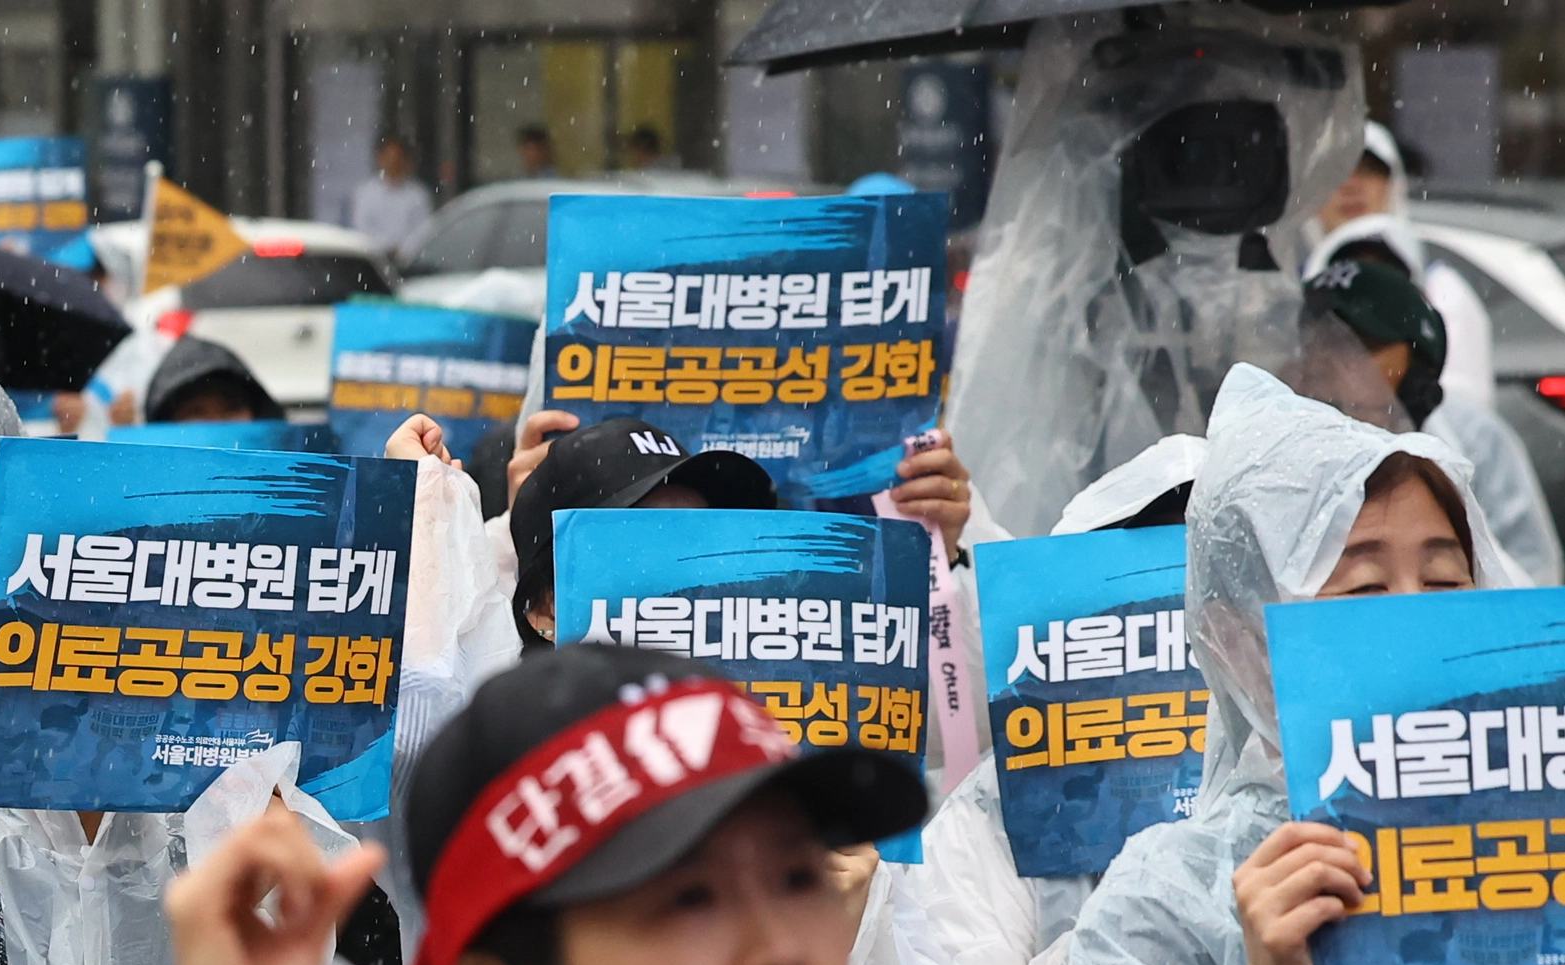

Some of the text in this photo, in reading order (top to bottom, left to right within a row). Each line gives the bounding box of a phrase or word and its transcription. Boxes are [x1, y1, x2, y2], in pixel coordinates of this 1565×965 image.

[566, 268, 930, 329] 서울대병원 답게
[554, 345, 829, 403] 의료공공성
[842, 341, 934, 400] 강화
[630, 431, 682, 456] NJ
[8, 535, 396, 614] 서울대병원 답게
[578, 597, 919, 668] 서울대병원 답게
[1006, 610, 1200, 683] 서울대
[306, 636, 393, 704] 강화
[155, 734, 195, 745] 공공운수노조
[735, 682, 848, 745] 공성
[859, 686, 922, 753] 강화
[486, 730, 642, 872] 단결
[1340, 819, 1565, 915] 의료공
